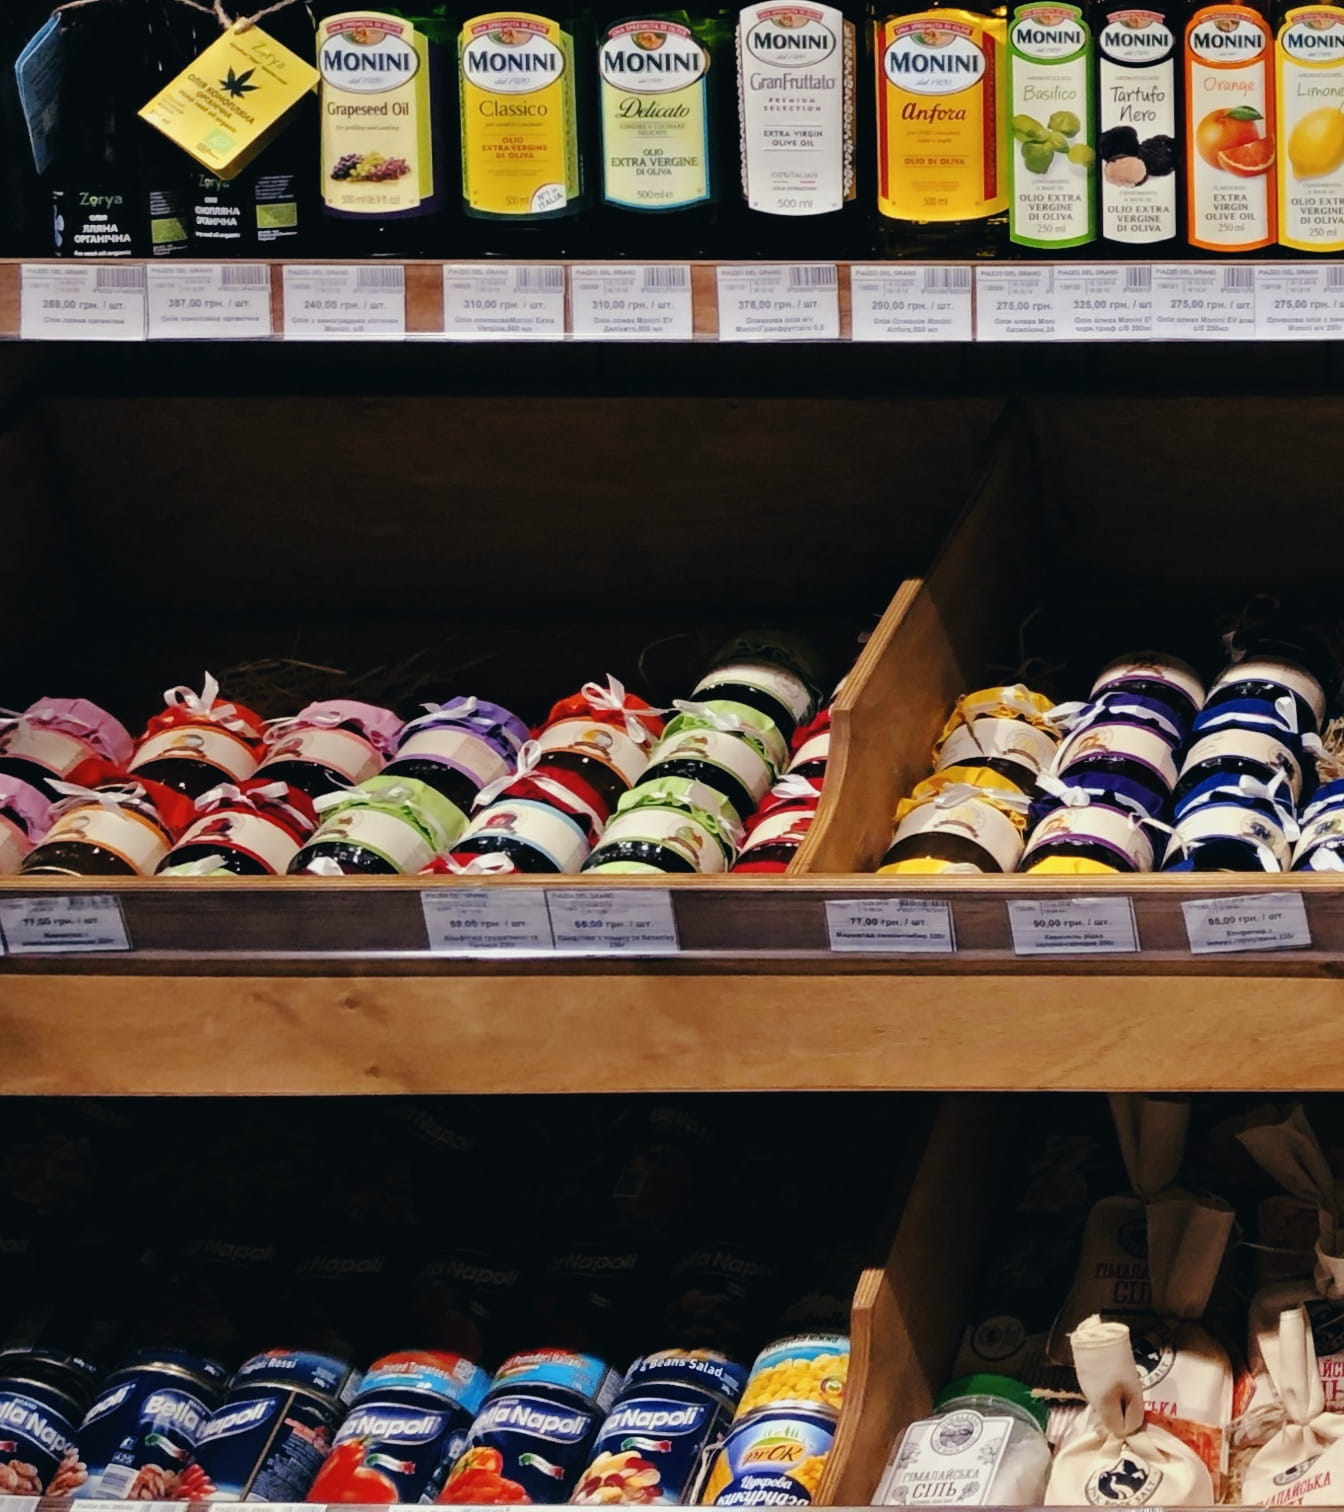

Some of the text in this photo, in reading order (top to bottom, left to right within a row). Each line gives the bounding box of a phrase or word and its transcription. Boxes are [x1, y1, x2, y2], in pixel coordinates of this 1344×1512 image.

[754, 31, 829, 50] MONINI
[1016, 29, 1081, 46] MONINI
[1104, 32, 1169, 48] MONINI
[1193, 33, 1262, 48] MONINI
[322, 50, 410, 74] MONINI
[468, 50, 556, 74] MONINI
[605, 50, 699, 74] MONINI
[890, 53, 979, 74] MONINI
[751, 73, 835, 92] GranFruttato
[1204, 75, 1256, 95] Orange
[1024, 83, 1077, 103] Basilico
[1110, 86, 1165, 103] Tartufo
[327, 100, 410, 120] Grapeseed Oil
[479, 100, 548, 118] Classico
[616, 94, 690, 119] Delicato
[901, 103, 967, 123] Anfora
[1120, 105, 1157, 123] Nero
[611, 157, 698, 167] EXTRA VERGINE
[1019, 194, 1082, 202] OLIO EXTRA
[1027, 203, 1074, 212] VERGINE
[1028, 212, 1074, 221] DI OLIVA
[689, 1359, 723, 1377] Salad
[145, 1394, 199, 1432] Bella
[508, 1409, 583, 1434] Napoli
[622, 1406, 697, 1429] Napoli
[358, 1415, 436, 1437] Napoli
[911, 1480, 957, 1497] СІЛЬ
